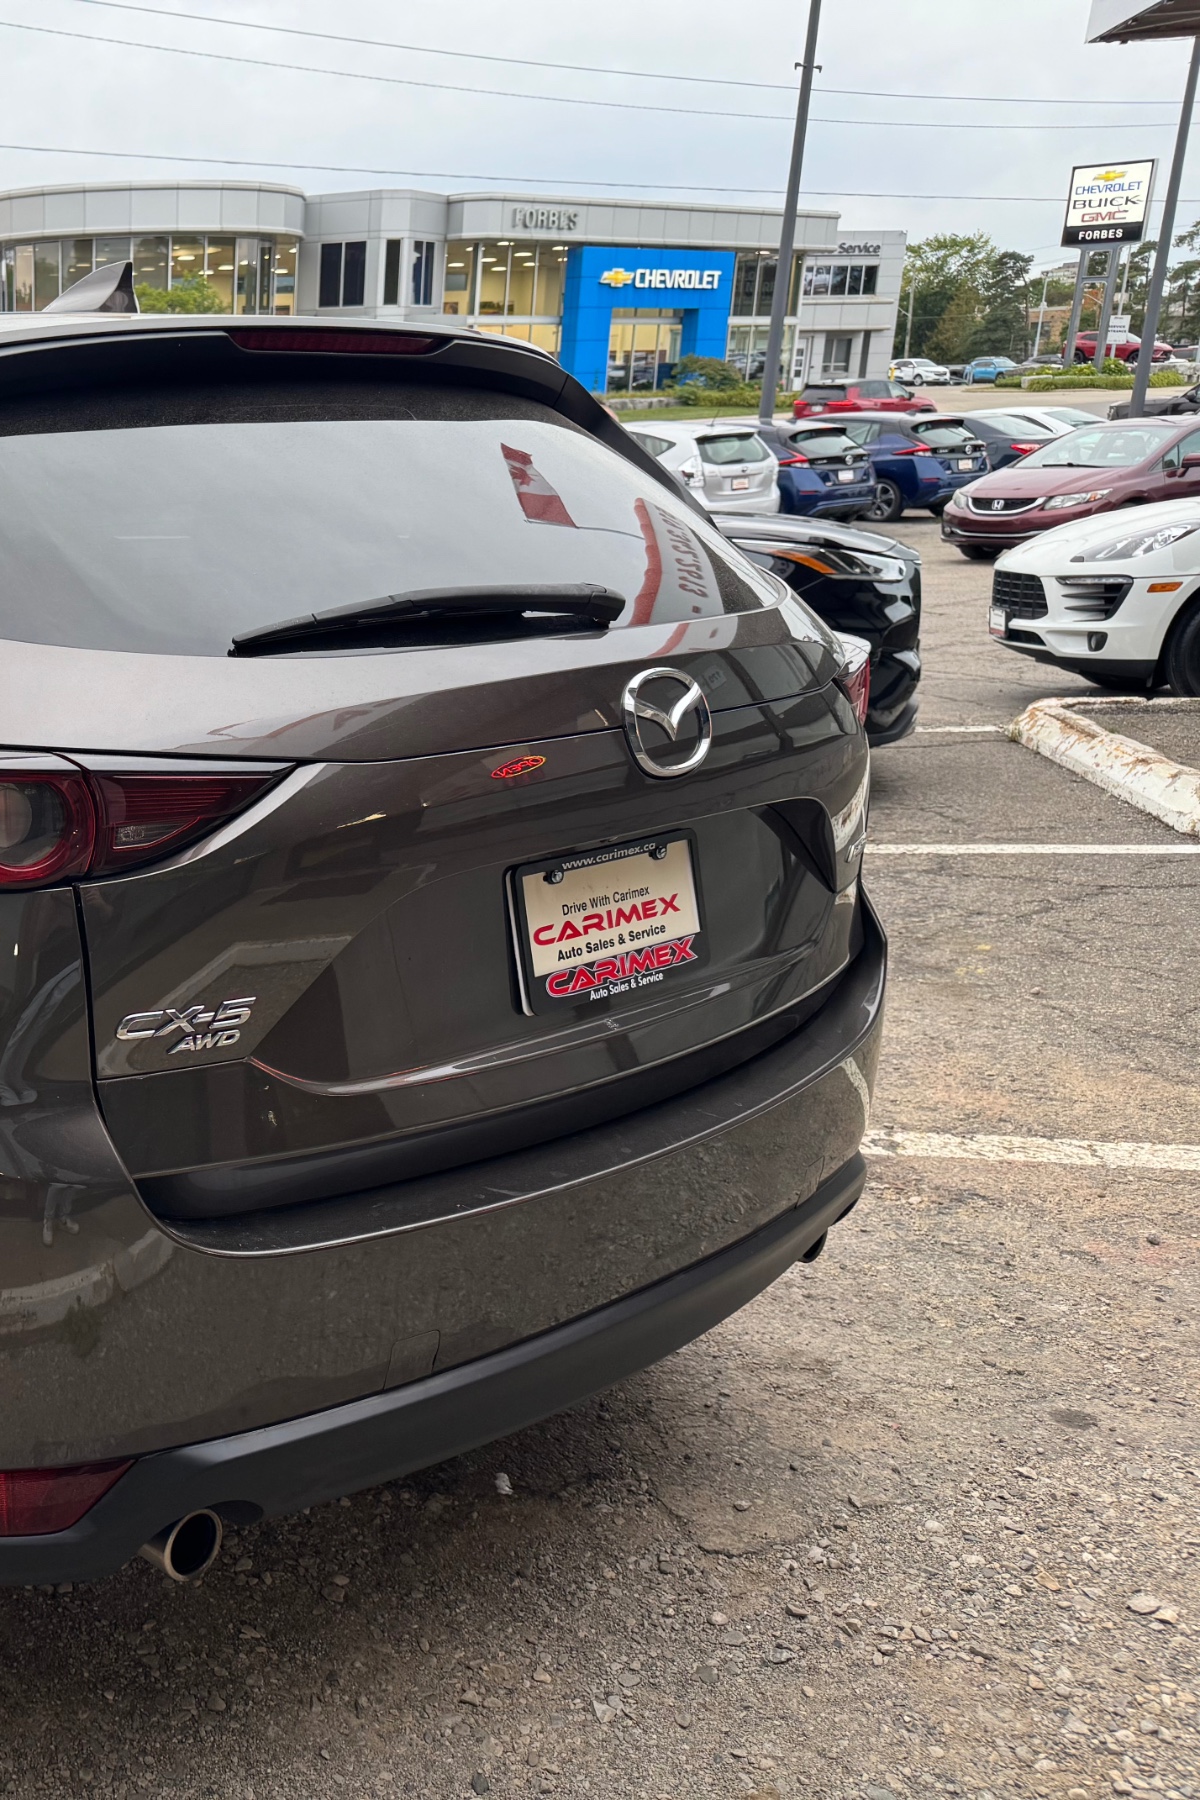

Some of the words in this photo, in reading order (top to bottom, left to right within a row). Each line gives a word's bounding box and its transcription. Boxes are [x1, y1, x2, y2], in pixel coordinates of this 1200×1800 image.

[1075, 181, 1143, 195] CHEVROLET
[1073, 195, 1141, 210] BUICK
[513, 207, 579, 231] FORBES
[1081, 210, 1129, 223] GMC
[1078, 229, 1124, 240] FORBES
[838, 242, 881, 254] Service
[634, 268, 722, 290] CHEVROLET
[562, 842, 656, 870] www.carimex.ca
[562, 902, 587, 916] Drive
[589, 895, 610, 909] With
[612, 886, 650, 903] Carimex
[533, 893, 681, 946] CARIMEX
[557, 945, 583, 962] Auto
[586, 937, 615, 954] Sales
[618, 933, 626, 945] &
[629, 924, 666, 942] Service
[546, 935, 698, 997] CARIMEX
[590, 985, 608, 1001] Auto
[610, 982, 629, 995] Sales
[631, 979, 637, 988] &
[638, 972, 663, 986] Service
[116, 996, 257, 1041] CX-5
[167, 1029, 241, 1055] AWD
